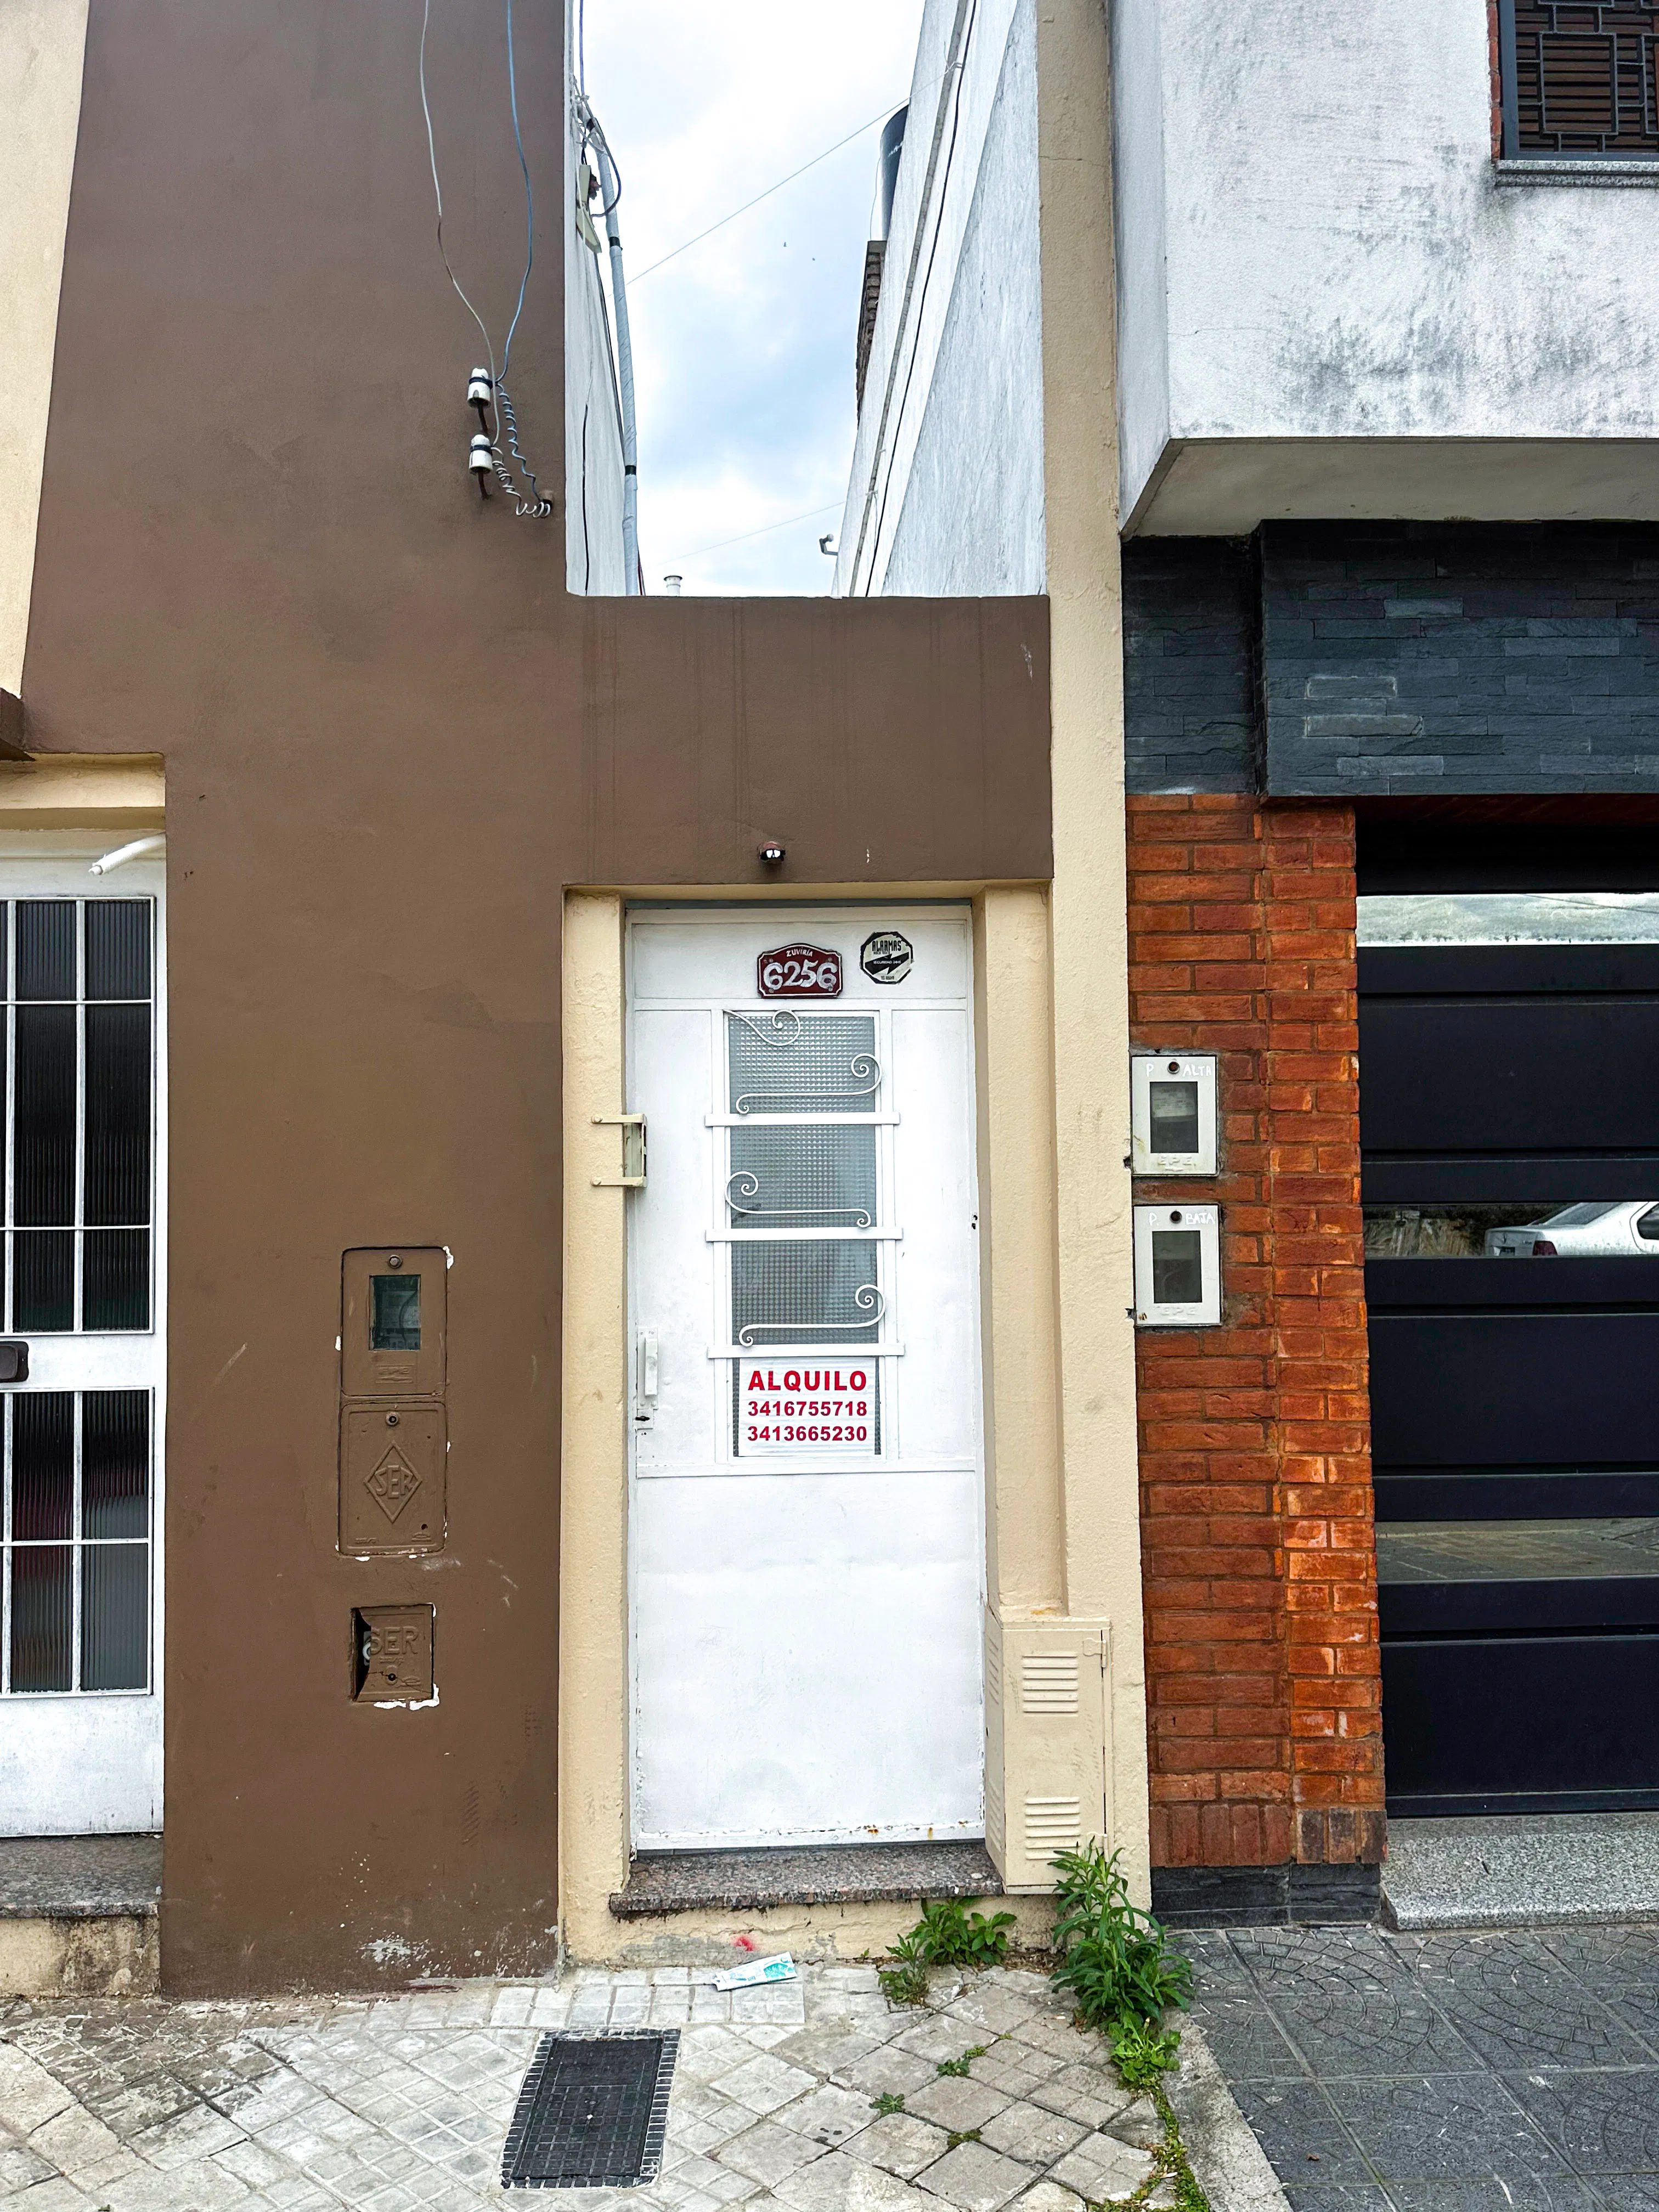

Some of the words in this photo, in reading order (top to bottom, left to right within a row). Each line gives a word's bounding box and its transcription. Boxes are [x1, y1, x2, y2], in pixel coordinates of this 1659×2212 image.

[872, 940, 901, 951] ALARMAS
[763, 960, 838, 990] 6256
[1146, 1063, 1154, 1077] P
[1182, 1064, 1211, 1077] ALTA
[1186, 1212, 1215, 1225] BAJA
[748, 1370, 866, 1392] ALQUILO
[748, 1401, 867, 1416] 3416755718
[748, 1426, 867, 1441] 3413665230
[374, 1465, 413, 1499] SER
